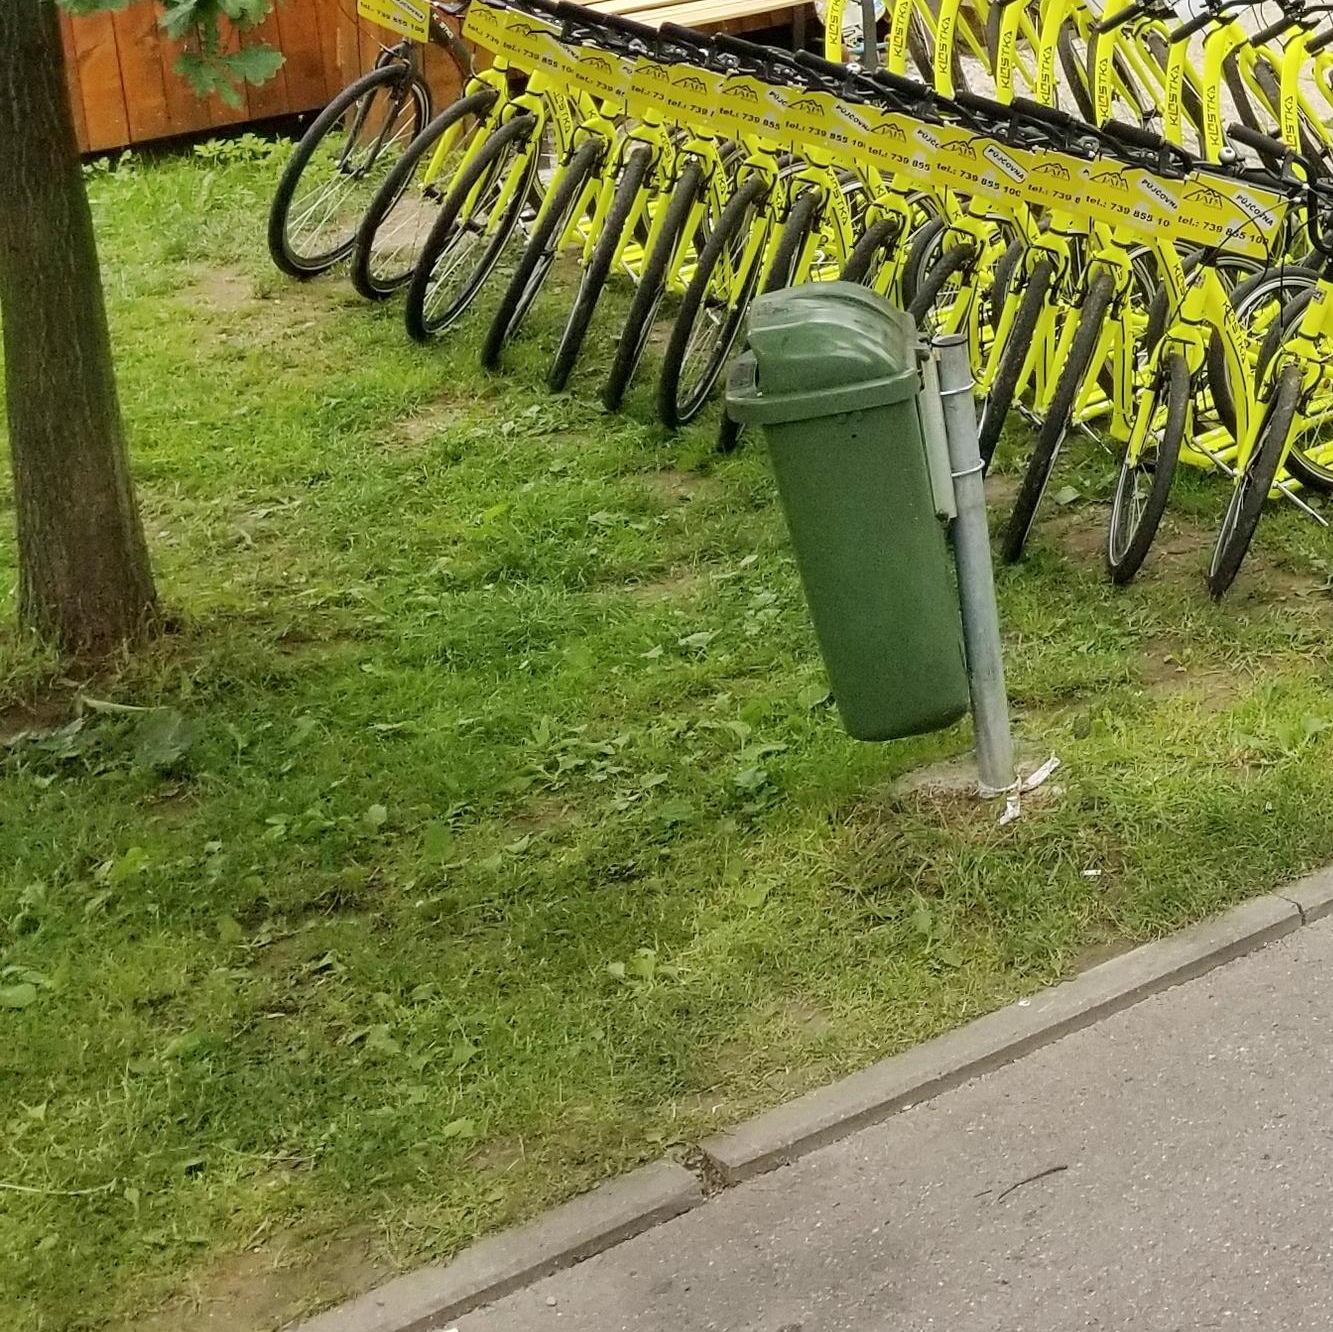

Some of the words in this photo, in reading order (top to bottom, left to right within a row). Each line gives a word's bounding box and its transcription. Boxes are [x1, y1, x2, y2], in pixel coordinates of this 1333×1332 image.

[467, 23, 484, 38] tel.:
[893, 1, 909, 58] KOSTKA
[502, 41, 521, 54] tel.:
[939, 17, 951, 74] KOSTKA
[1001, 31, 1013, 89] KOSTKA
[1040, 46, 1053, 106] KOSTKA
[1097, 58, 1109, 119] KOSTKA
[667, 99, 687, 110] tel.:
[690, 104, 708, 116] 739
[1168, 64, 1181, 126] KOSTKA
[719, 107, 739, 118] tel.:
[742, 113, 760, 124] 739
[762, 118, 781, 131] 855
[1205, 84, 1219, 146] KOSTKA
[1284, 95, 1298, 154] OSTKA
[785, 121, 805, 132] tel.:
[808, 126, 827, 138] 739
[829, 131, 848, 144] 855
[868, 146, 888, 158] tel.:
[890, 153, 909, 165] 739
[911, 159, 931, 172] 855
[987, 148, 1025, 181] PŮJČOVNA
[936, 163, 957, 176] tel.:
[960, 170, 979, 182] 739
[981, 177, 1000, 190] 855
[1027, 183, 1049, 196] tel.:
[1052, 190, 1072, 202] 739
[1085, 195, 1107, 208] tel.:
[1110, 202, 1130, 215] 739
[1133, 210, 1153, 222] 855
[1235, 193, 1274, 227] PŮJČOVNA
[1177, 215, 1200, 228] tel.:
[1203, 221, 1223, 233] 739
[1249, 234, 1269, 245] 100
